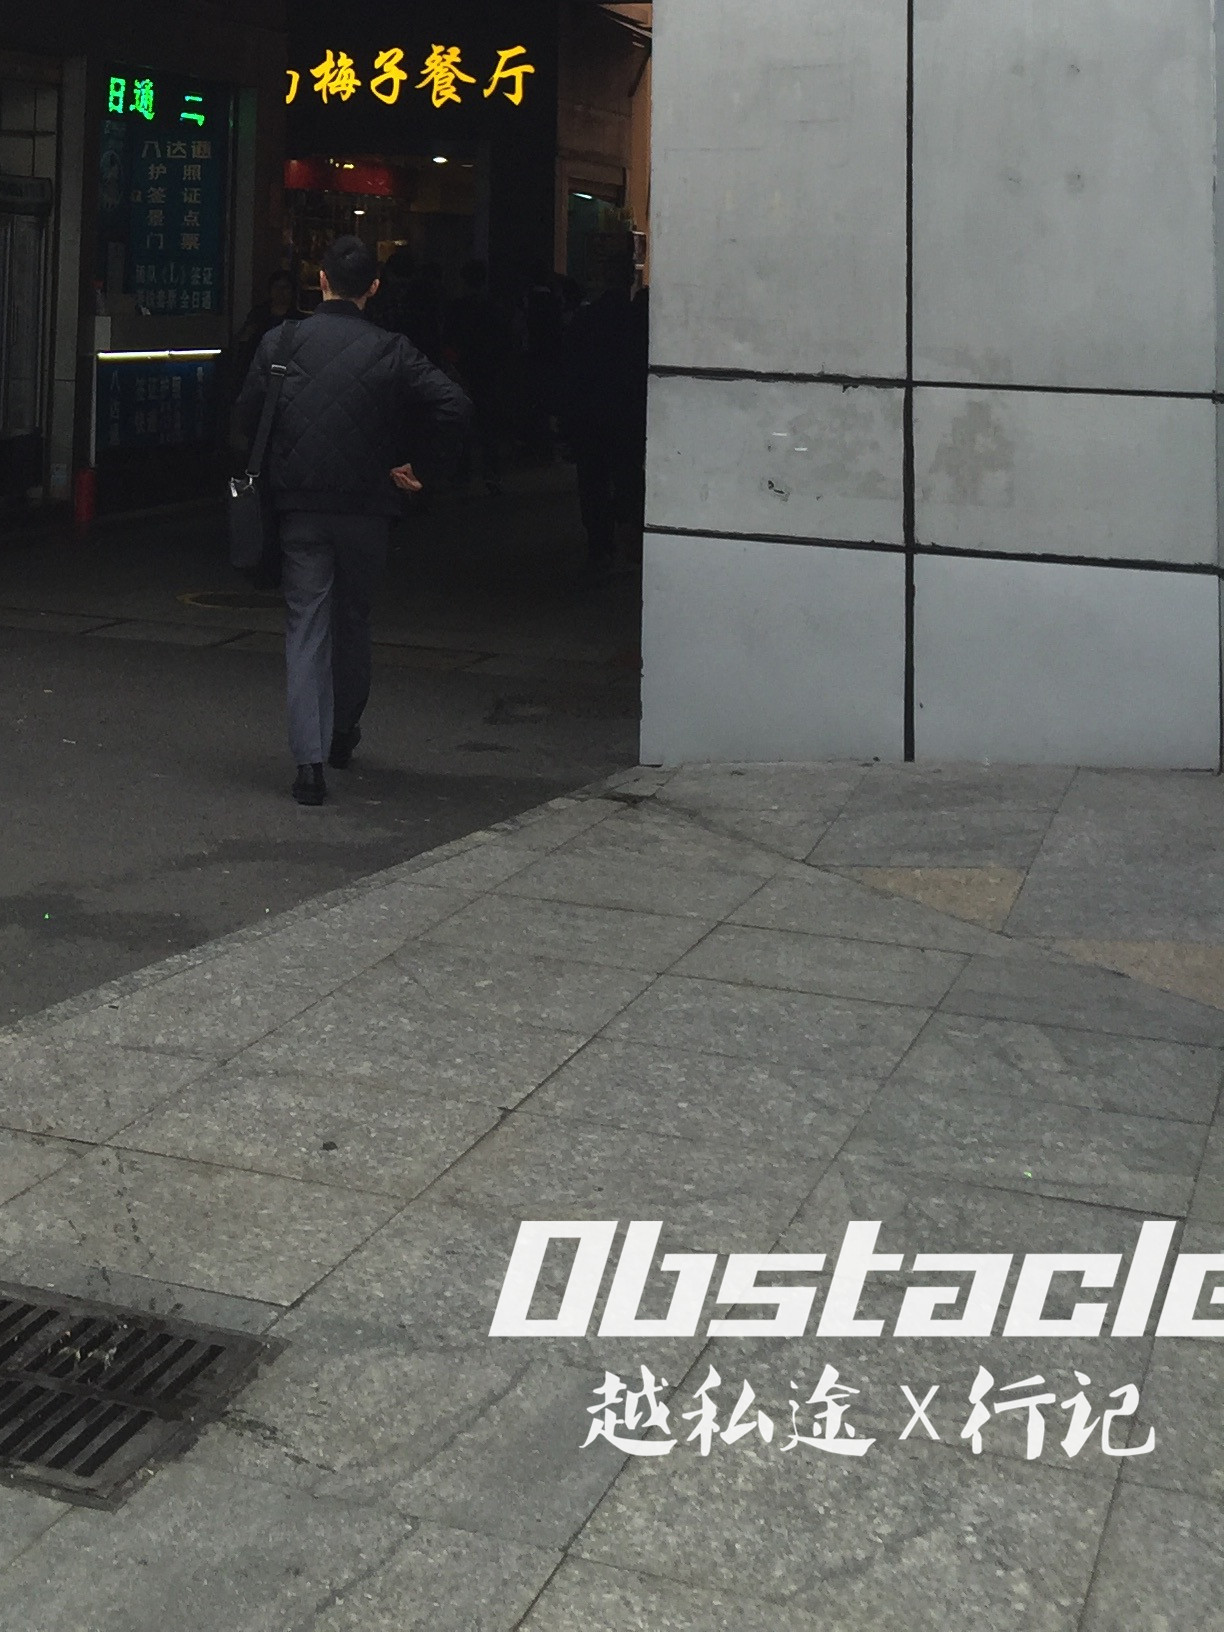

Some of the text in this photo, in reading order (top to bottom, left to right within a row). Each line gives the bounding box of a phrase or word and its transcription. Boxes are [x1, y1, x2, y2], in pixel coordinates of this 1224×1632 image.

[285, 43, 536, 109] 梅子餐厅
[107, 76, 155, 121] 日通
[141, 140, 213, 159] 八达通
[147, 163, 203, 181] 护照
[147, 187, 203, 205] 签证
[146, 209, 201, 227] 景点
[146, 233, 201, 251] 门票
